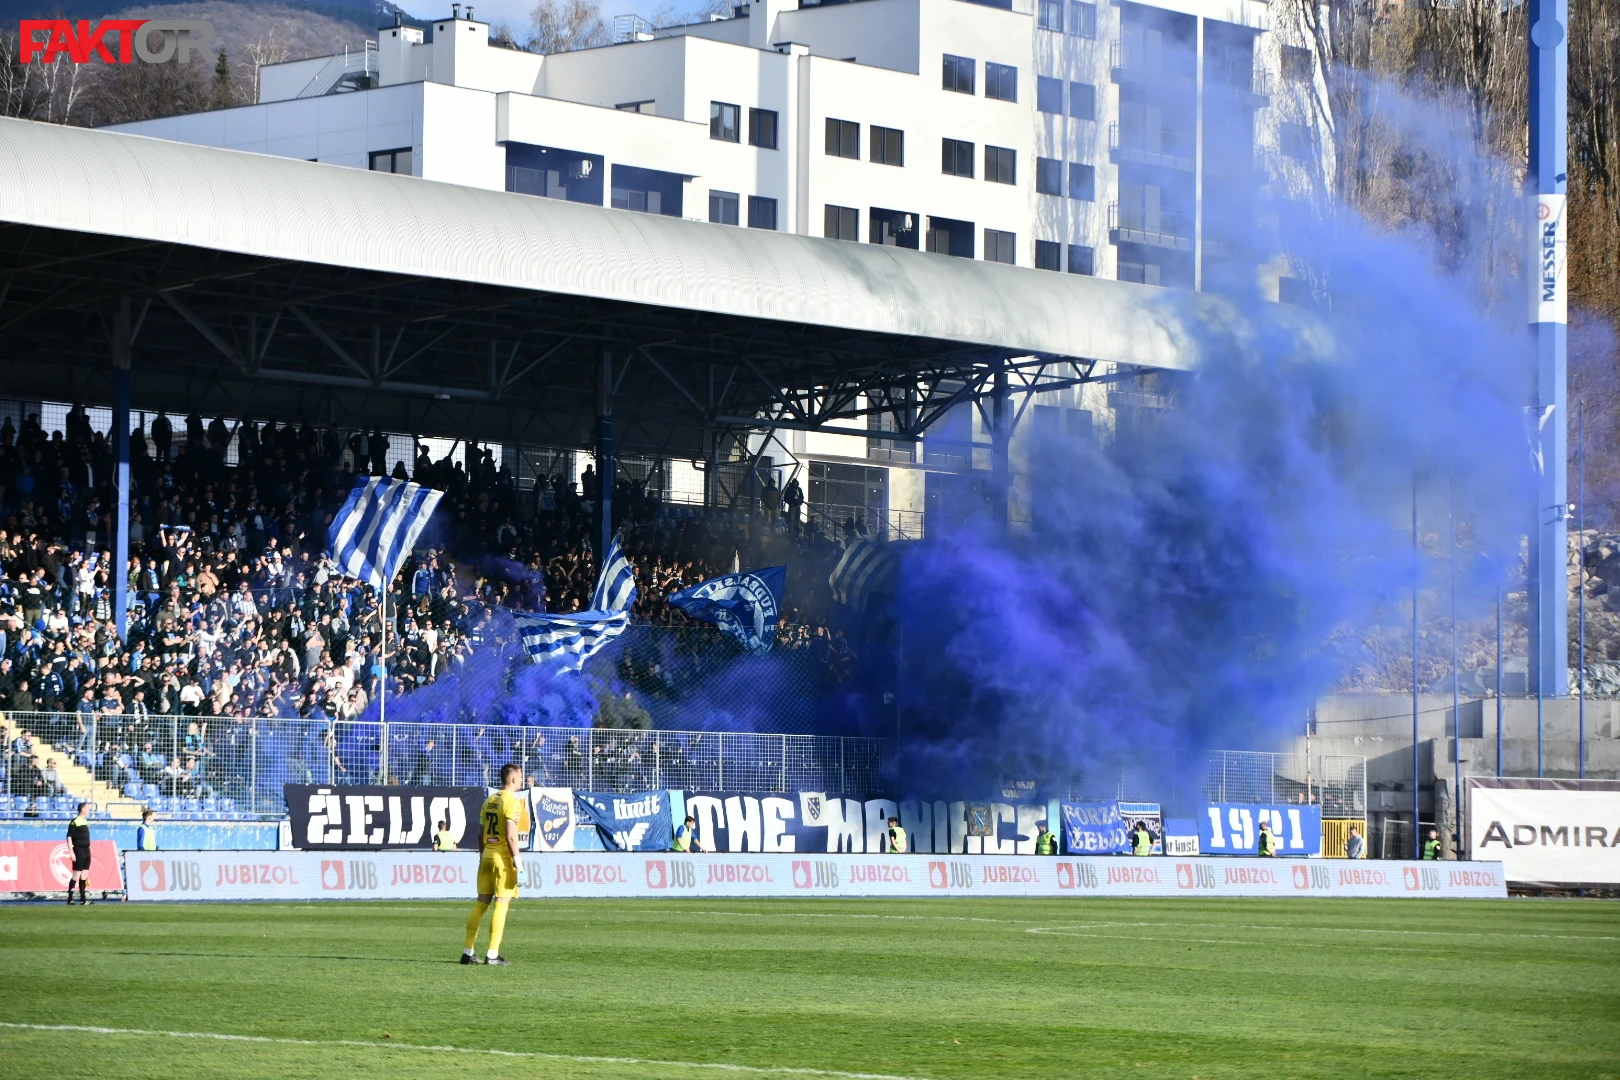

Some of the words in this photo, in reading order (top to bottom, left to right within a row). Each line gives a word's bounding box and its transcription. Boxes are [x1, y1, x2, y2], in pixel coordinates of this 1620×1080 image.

[1543, 221, 1556, 301] MESSER
[613, 795, 660, 820] limit
[1062, 804, 1118, 825] FORZA
[486, 812, 499, 835] 72
[687, 796, 795, 853] THE
[1208, 807, 1304, 849] 1921
[170, 861, 202, 891] JUB
[215, 864, 299, 887] JUBIZOL
[348, 861, 378, 890] JUB
[391, 864, 468, 885] JUBIZOL
[522, 860, 542, 889] UB
[555, 864, 626, 885] JUBIZOL
[670, 861, 695, 888] JUB
[707, 864, 773, 884] JUBIZOL
[815, 861, 839, 888] JUB
[850, 865, 912, 883] JUBIZOL
[950, 862, 972, 888] JUB
[983, 866, 1040, 884] JUBIZOL
[1077, 863, 1098, 888] JUB
[1107, 867, 1162, 884] JUBIZOL
[1196, 864, 1216, 889] JUB
[1225, 868, 1278, 884] JUBIZOL
[1311, 866, 1331, 889] JUB
[1339, 869, 1390, 885] JUBIZOL
[1421, 867, 1441, 890] JUB
[1449, 871, 1498, 887] JUBIZOL
